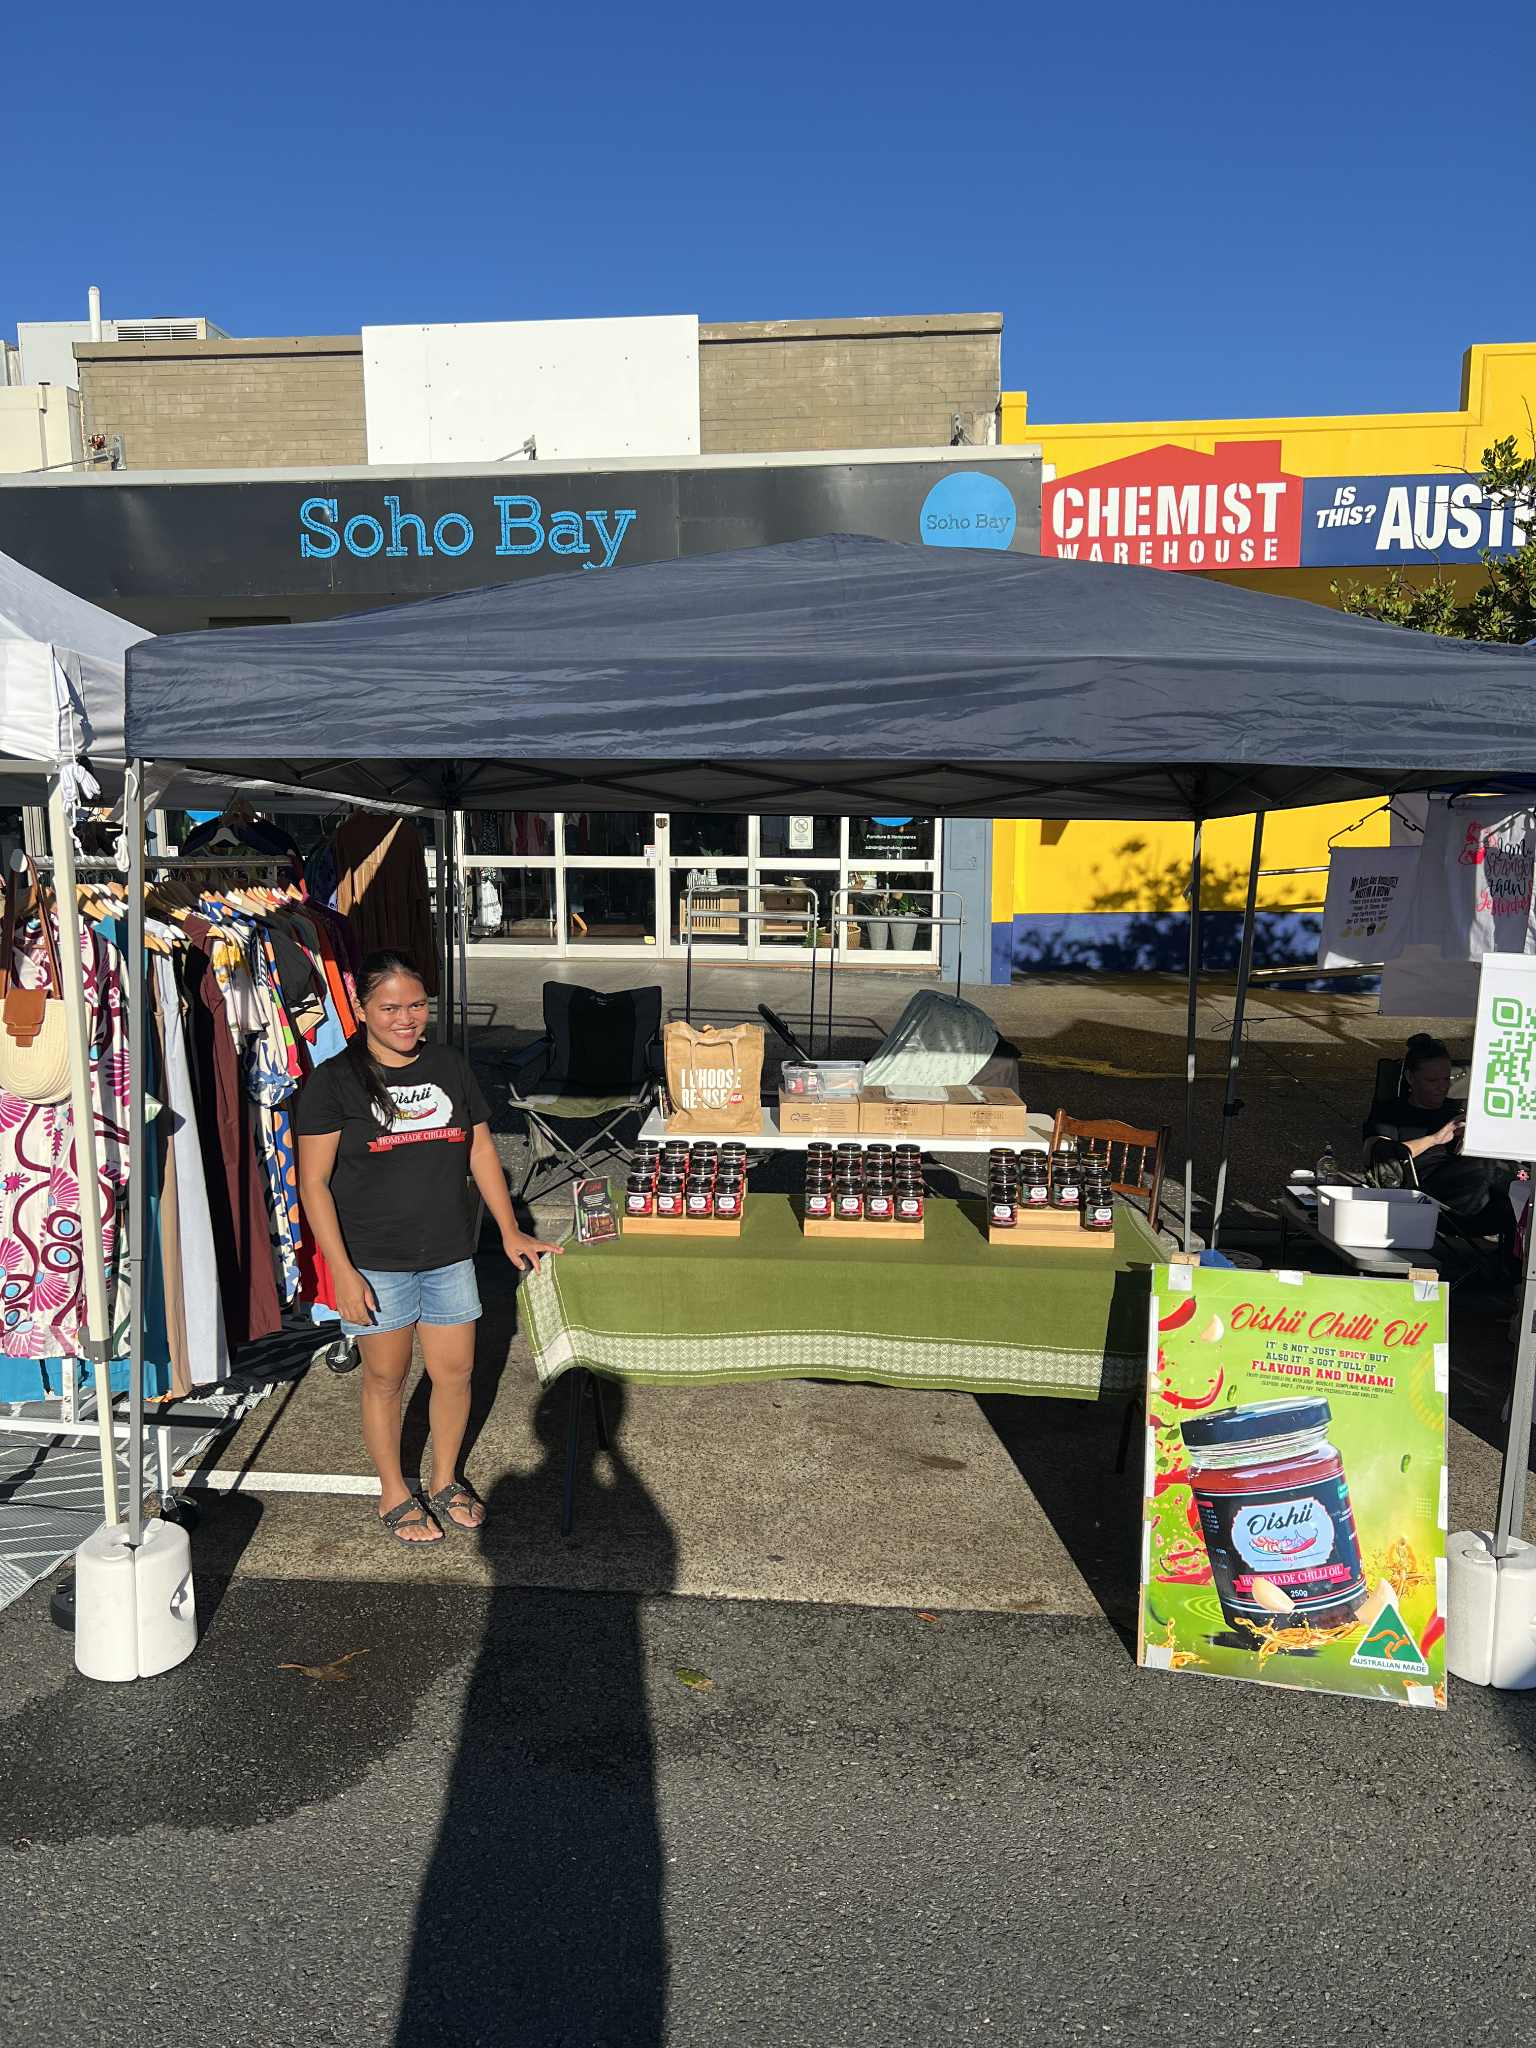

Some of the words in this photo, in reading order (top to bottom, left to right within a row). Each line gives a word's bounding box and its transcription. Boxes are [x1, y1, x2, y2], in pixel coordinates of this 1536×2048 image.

[1334, 486, 1356, 507] IS
[1052, 482, 1287, 539] CHEMIST
[1317, 505, 1377, 528] THIS?
[299, 495, 474, 559] Soho
[494, 495, 637, 569] Bay
[926, 514, 970, 530] Soho
[975, 514, 1011, 534] Bay
[1056, 538, 1278, 565] WAREHOUSE
[681, 1068, 686, 1088] I
[379, 1131, 422, 1146] HOMEMADE
[1231, 1302, 1306, 1333] Oishii
[1308, 1311, 1379, 1341] Chilli
[1383, 1319, 1428, 1347] Oil
[1266, 1351, 1289, 1363] ALSO
[1317, 1357, 1334, 1368] GOT
[1337, 1360, 1362, 1371] FULL
[1364, 1363, 1376, 1373] OF
[1291, 1343, 1309, 1353] NOT
[1312, 1346, 1337, 1357] JUST
[1339, 1350, 1367, 1361] SPICY
[1369, 1353, 1388, 1363] BUT
[1252, 1360, 1311, 1377] FLAVOUR
[1316, 1368, 1341, 1381] AND
[1346, 1371, 1396, 1388] UMAMI
[1246, 1503, 1314, 1535] Oishii
[1242, 1573, 1298, 1586] HOMADE
[1298, 1569, 1328, 1582] CHILLI
[1329, 1566, 1344, 1577] OIL
[1290, 1589, 1308, 1598] 250g
[1352, 1657, 1401, 1669] AUSTRALIAN
[1402, 1663, 1427, 1673] MADE
